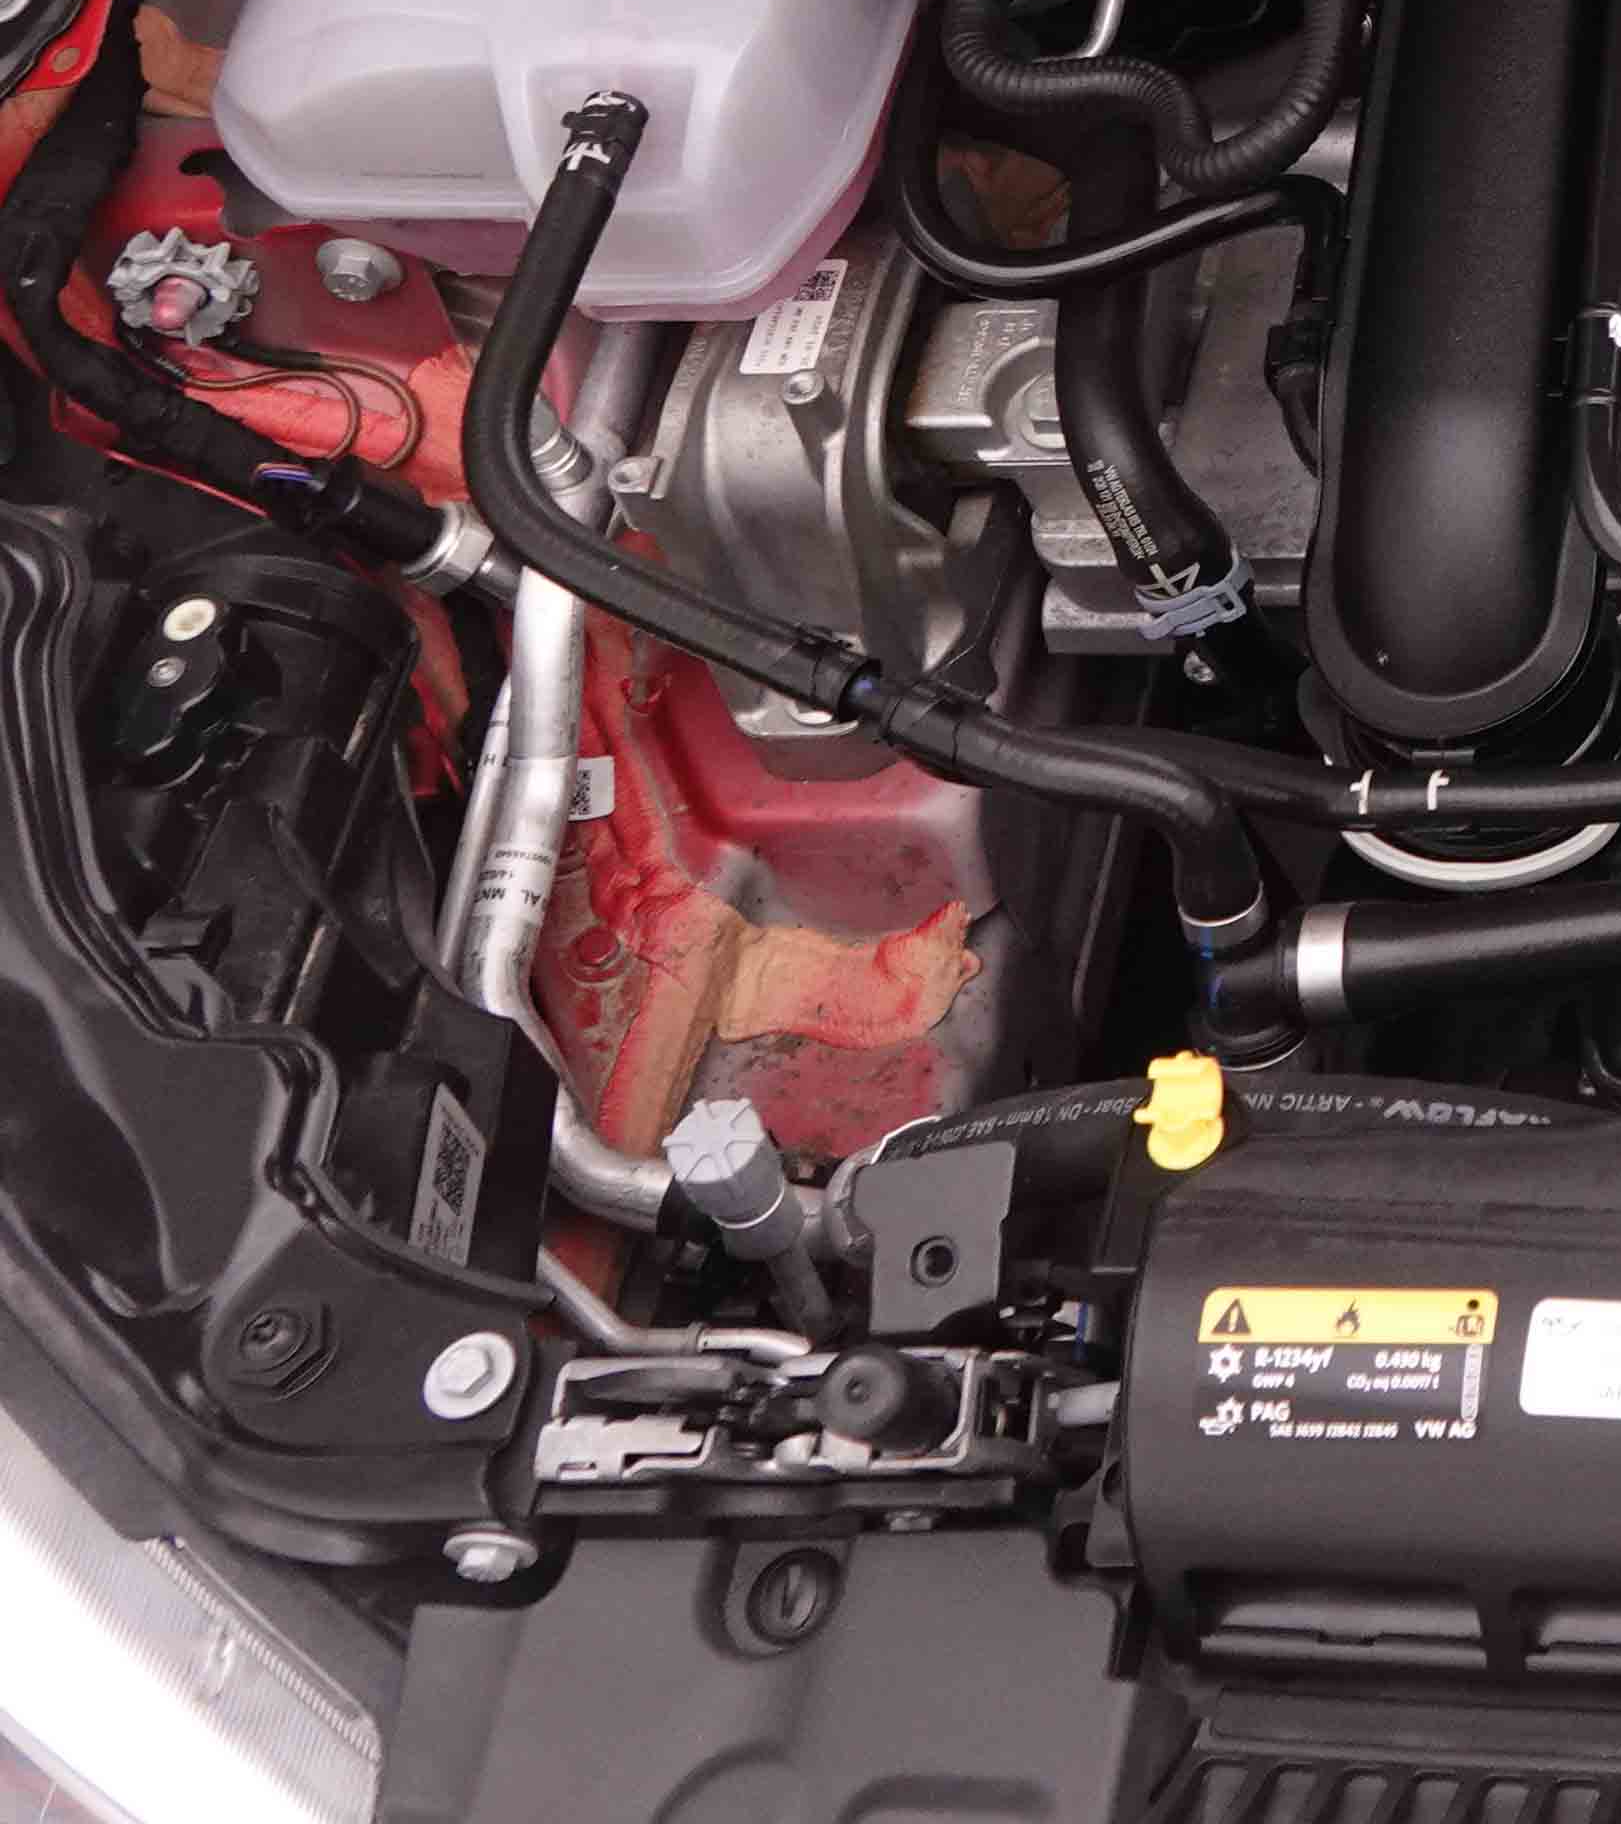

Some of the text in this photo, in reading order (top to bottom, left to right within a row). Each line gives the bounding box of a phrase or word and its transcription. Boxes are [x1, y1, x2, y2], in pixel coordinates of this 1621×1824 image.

[1280, 1094, 1352, 1112] ARTIC
[1421, 1352, 1442, 1373] kg
[1250, 1401, 1292, 1422] PAG
[1413, 1420, 1445, 1439] VW
[1448, 1420, 1477, 1439] AG
